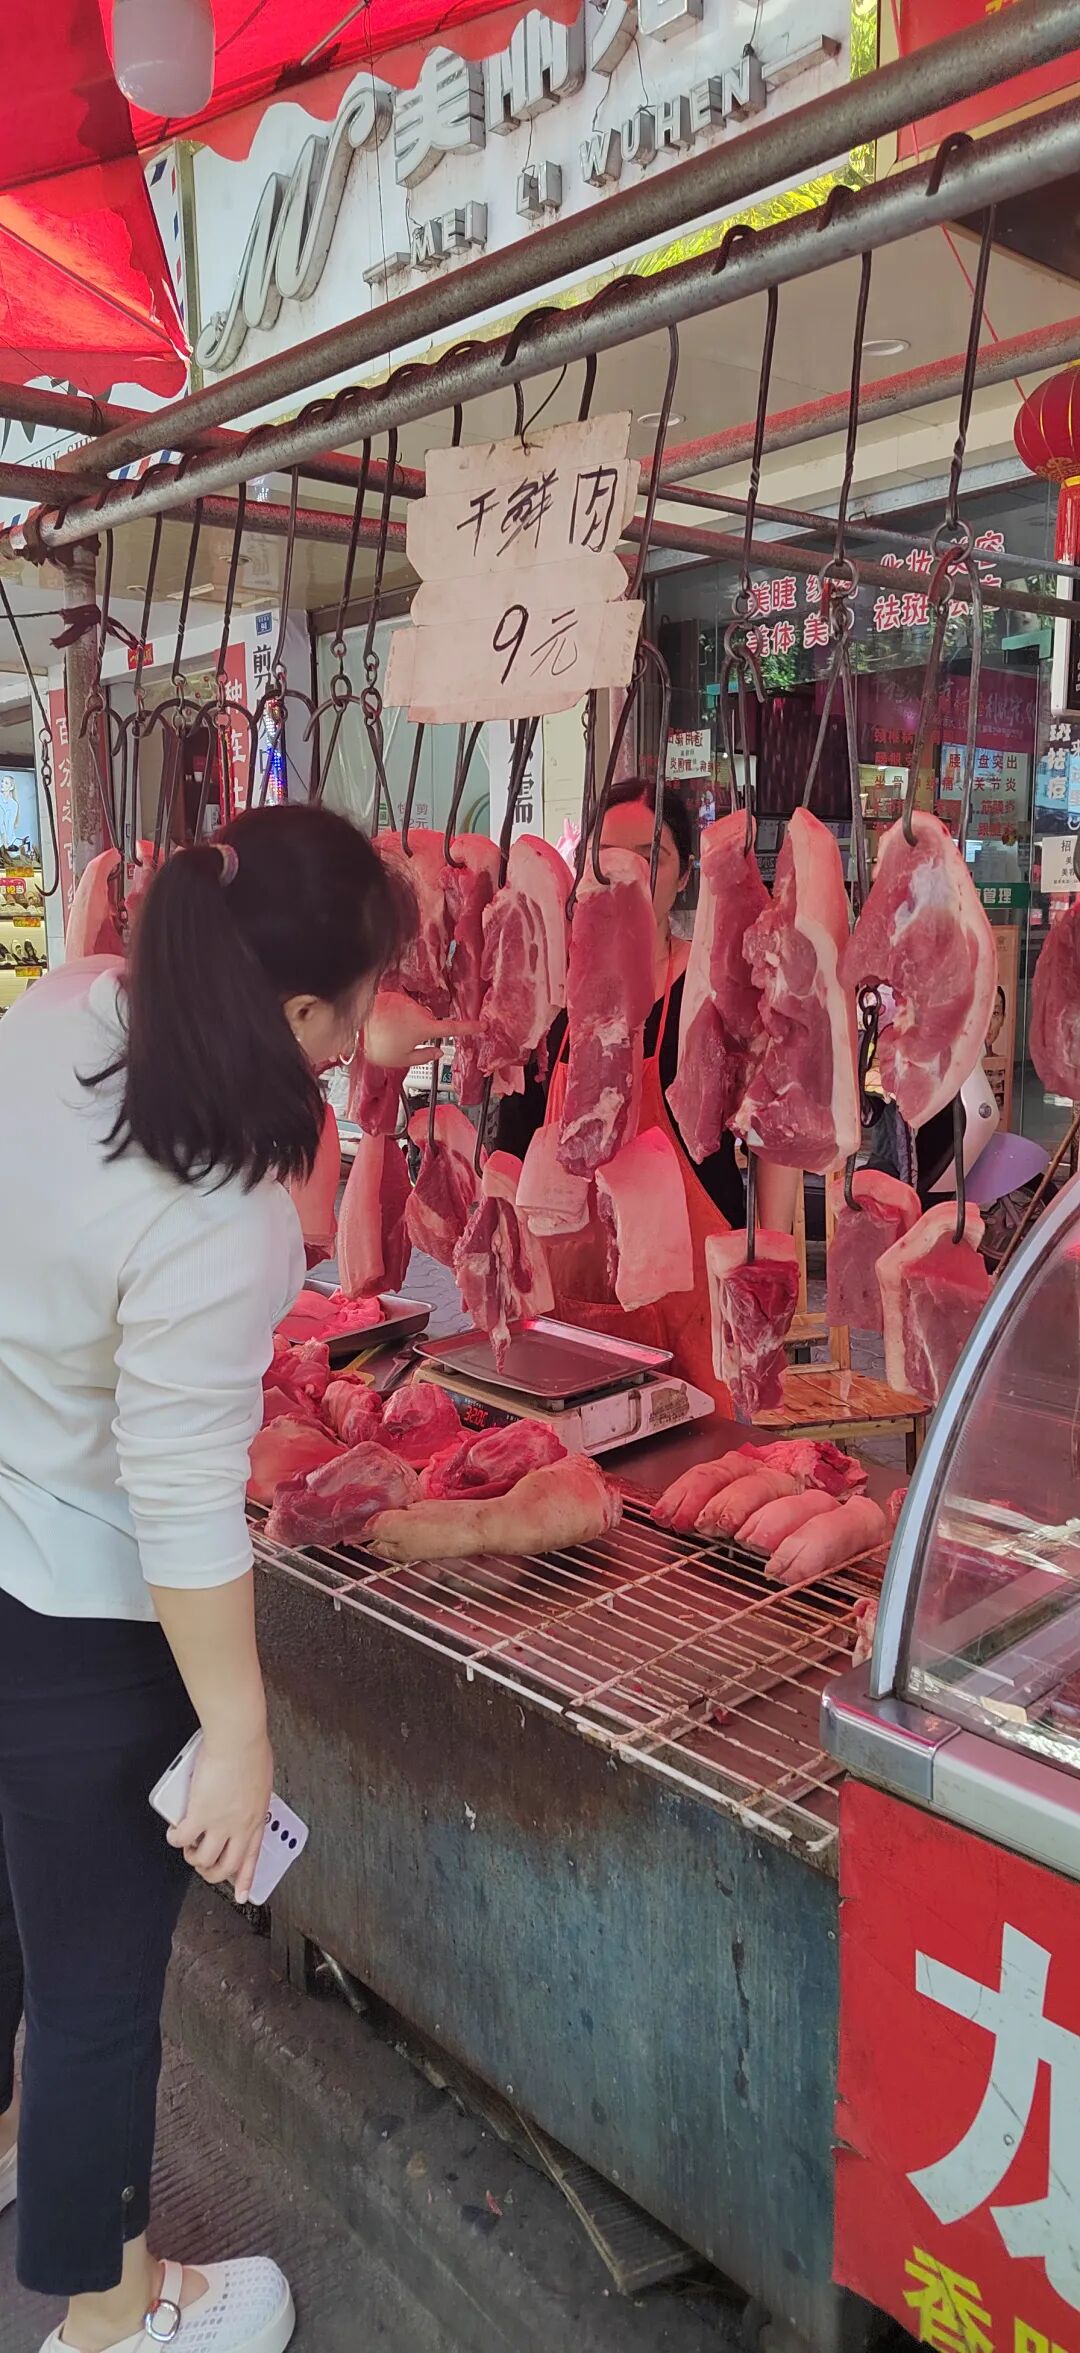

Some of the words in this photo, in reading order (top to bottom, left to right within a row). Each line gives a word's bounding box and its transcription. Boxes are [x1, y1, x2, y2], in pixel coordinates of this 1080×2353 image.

[411, 200, 487, 272] MEI
[516, 160, 562, 220] LI
[579, 54, 767, 188] WUHEN
[492, 604, 578, 685] 9元
[975, 887, 1012, 904] 管理
